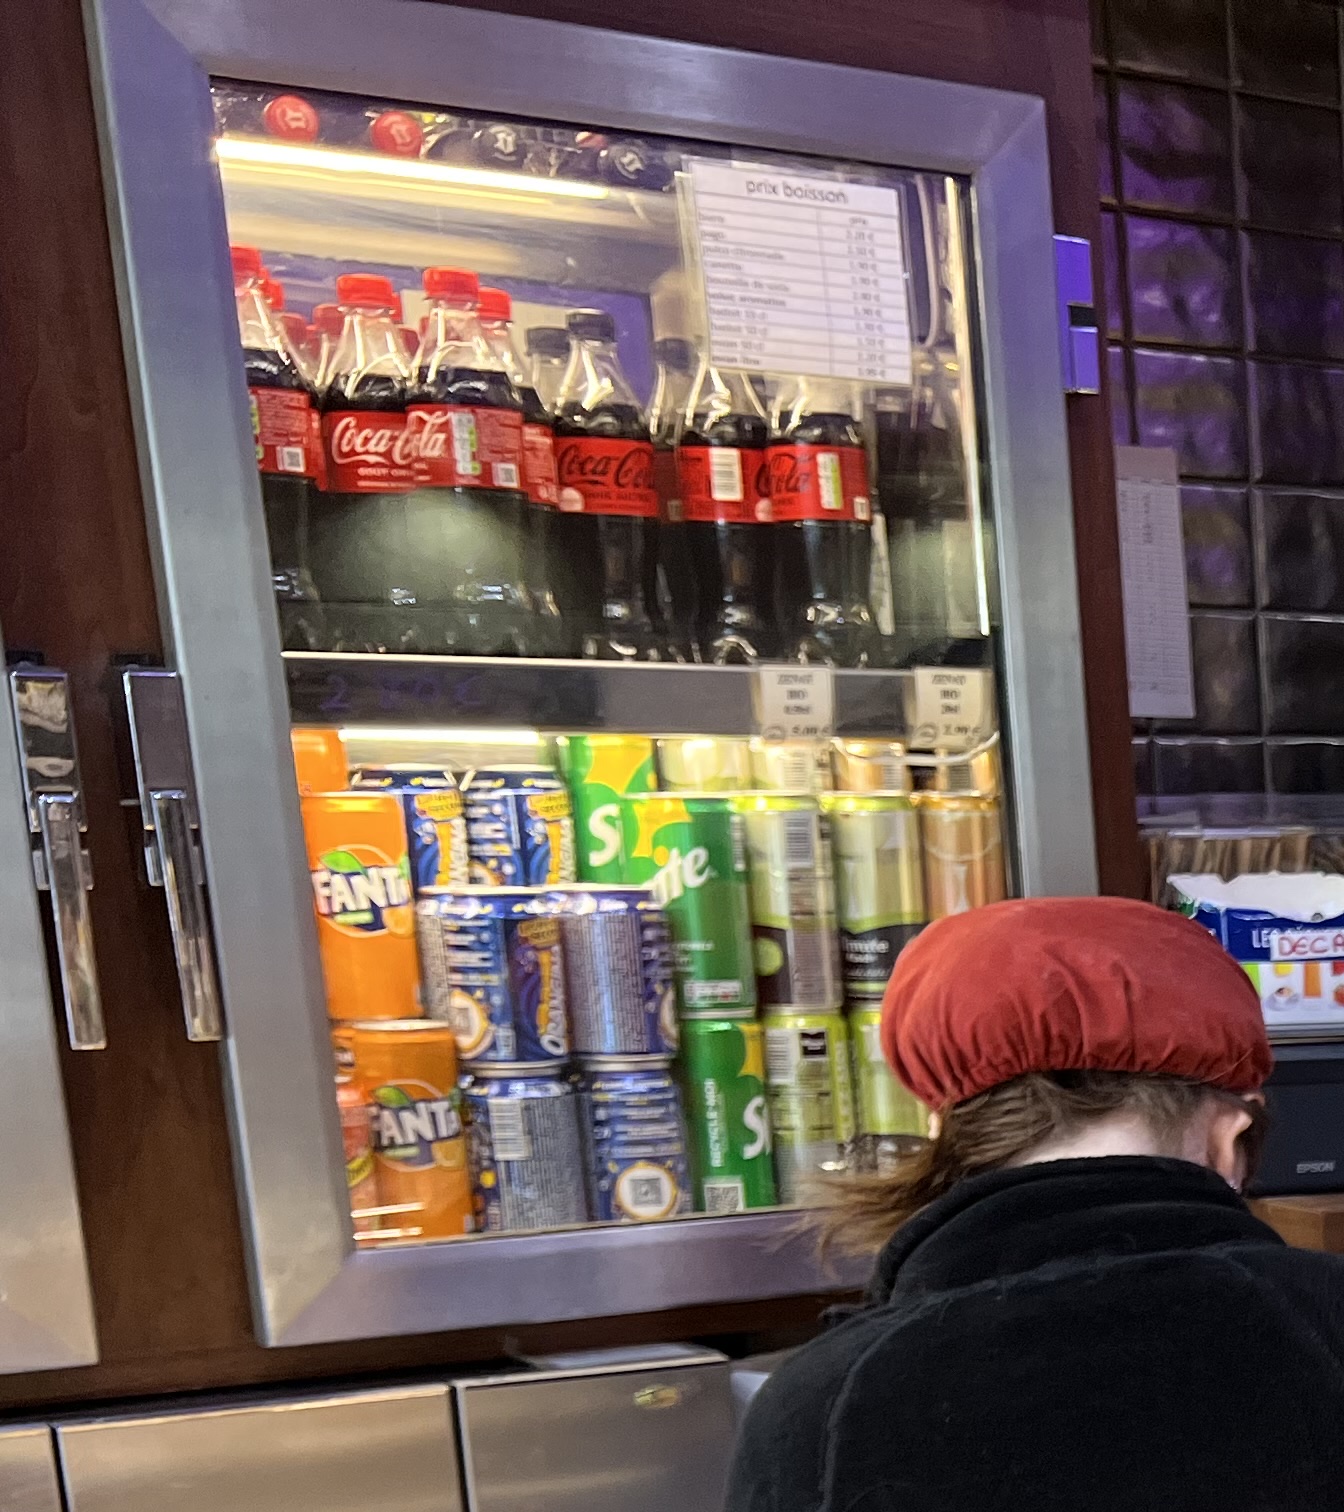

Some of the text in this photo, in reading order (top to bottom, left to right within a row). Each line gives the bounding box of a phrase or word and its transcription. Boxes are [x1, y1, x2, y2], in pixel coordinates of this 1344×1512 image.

[746, 179, 848, 203] prix boisson
[1296, 1161, 1336, 1174] EPSON
